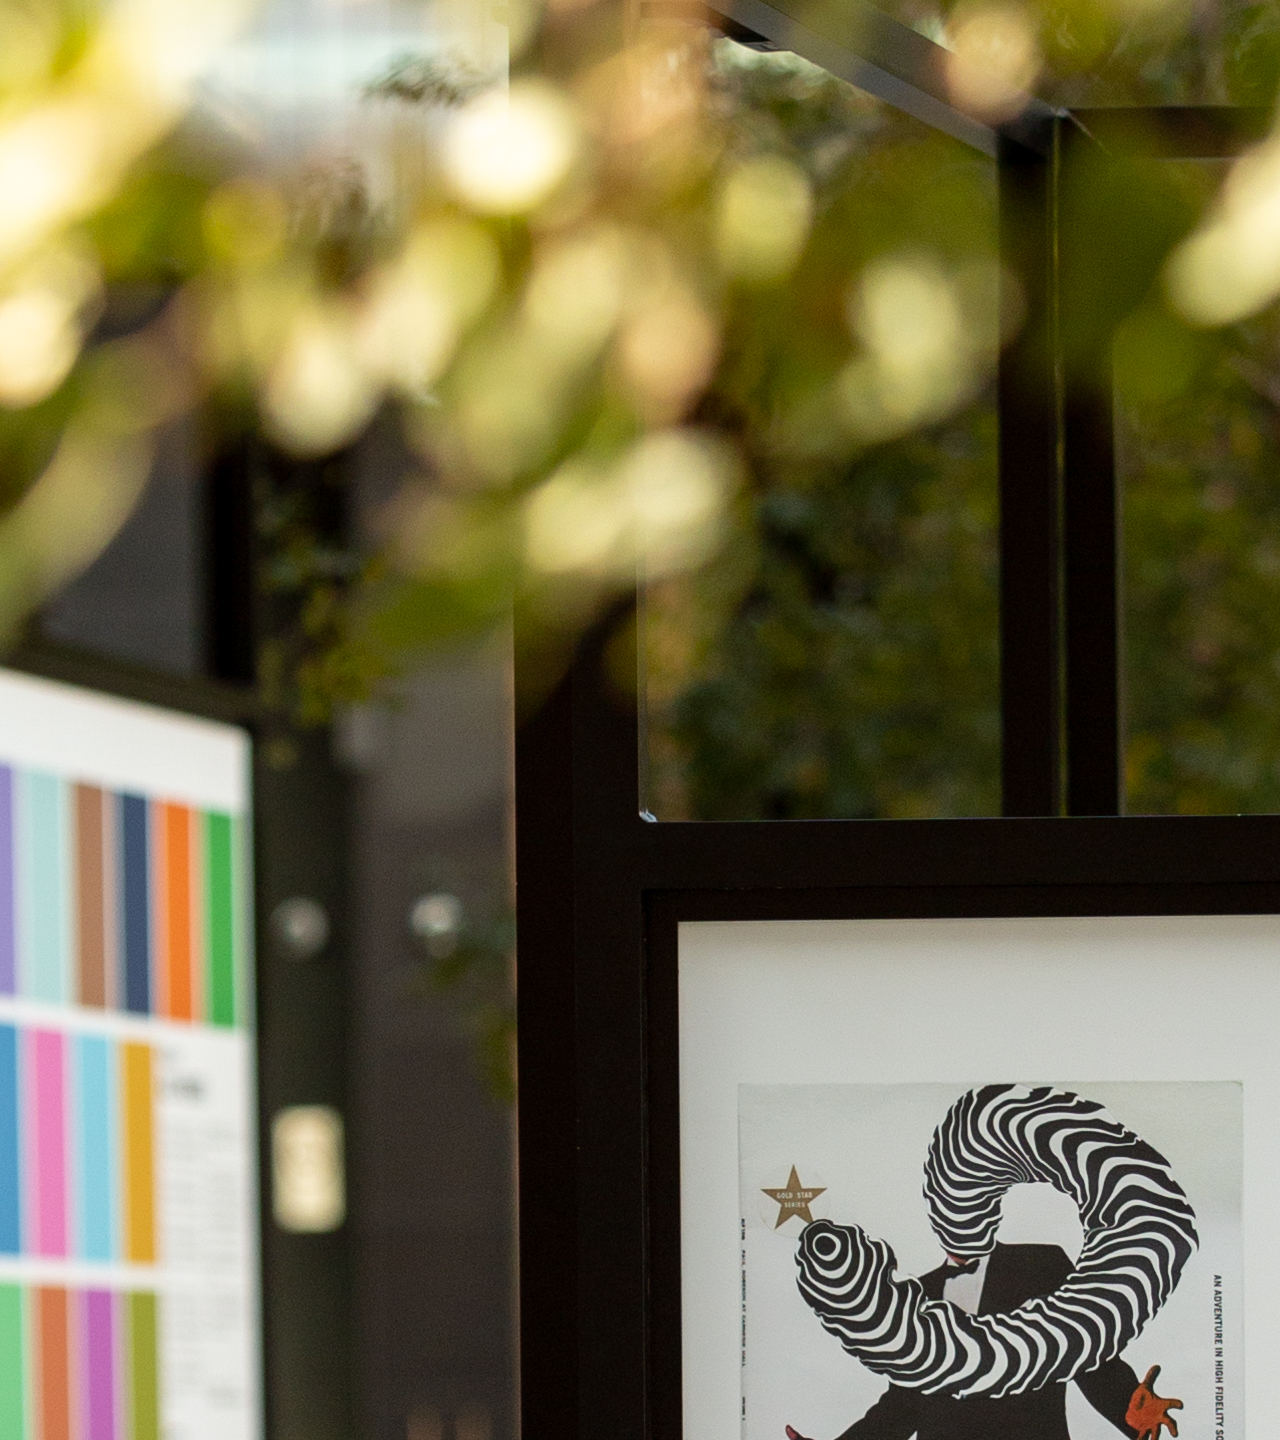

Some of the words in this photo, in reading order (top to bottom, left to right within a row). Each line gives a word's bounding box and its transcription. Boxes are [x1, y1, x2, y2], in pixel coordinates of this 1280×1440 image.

[796, 1191, 813, 1199] STAR
[1214, 1274, 1222, 1287] AN
[1214, 1289, 1223, 1345] ADVENTURE
[1215, 1347, 1223, 1357] IN
[1215, 1360, 1223, 1383] HIGH
[1215, 1386, 1224, 1427] FIDELITY
